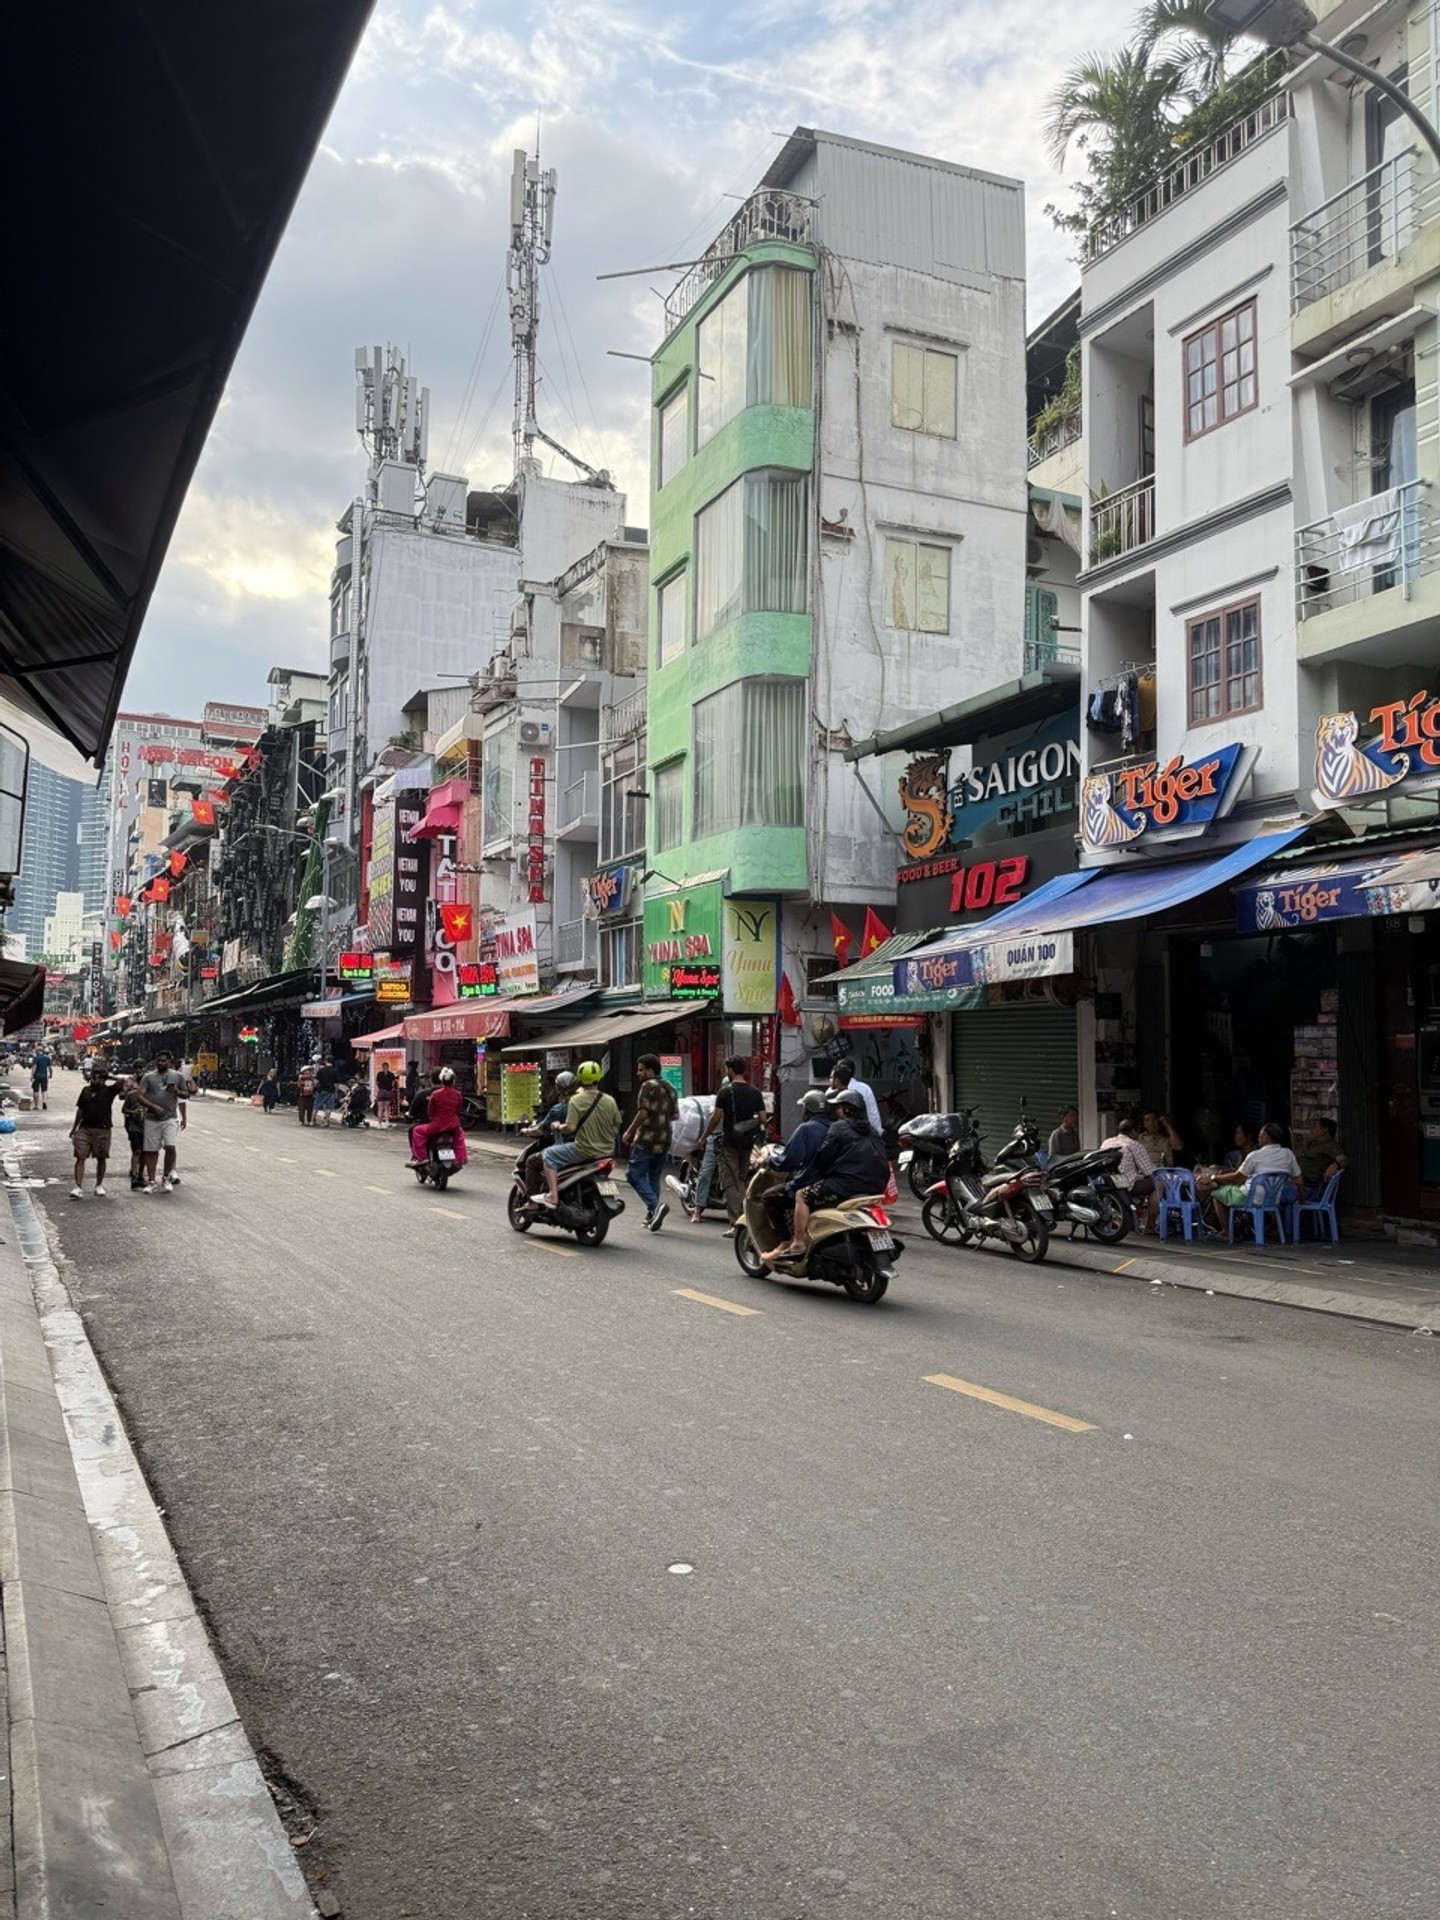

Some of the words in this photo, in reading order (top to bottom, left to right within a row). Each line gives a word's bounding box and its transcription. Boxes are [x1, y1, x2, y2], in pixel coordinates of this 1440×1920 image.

[967, 738, 1081, 802] SAIGON
[1119, 754, 1220, 825] Tiger
[896, 867, 922, 882] FOOD
[923, 864, 931, 877] &
[932, 858, 957, 875] BEER
[949, 855, 1028, 912] 102
[399, 878, 417, 892] YOU
[1278, 882, 1342, 921] Tiger
[398, 928, 415, 942] YOU
[517, 924, 534, 953] SPA
[647, 938, 682, 963] YUNA
[684, 933, 713, 959] SPA
[726, 949, 774, 976] Yuna
[1007, 943, 1035, 967] QUÁN
[1037, 943, 1056, 961] 100
[919, 957, 957, 988] Tiger
[733, 978, 766, 1005] Spa
[871, 984, 895, 997] FOOD
